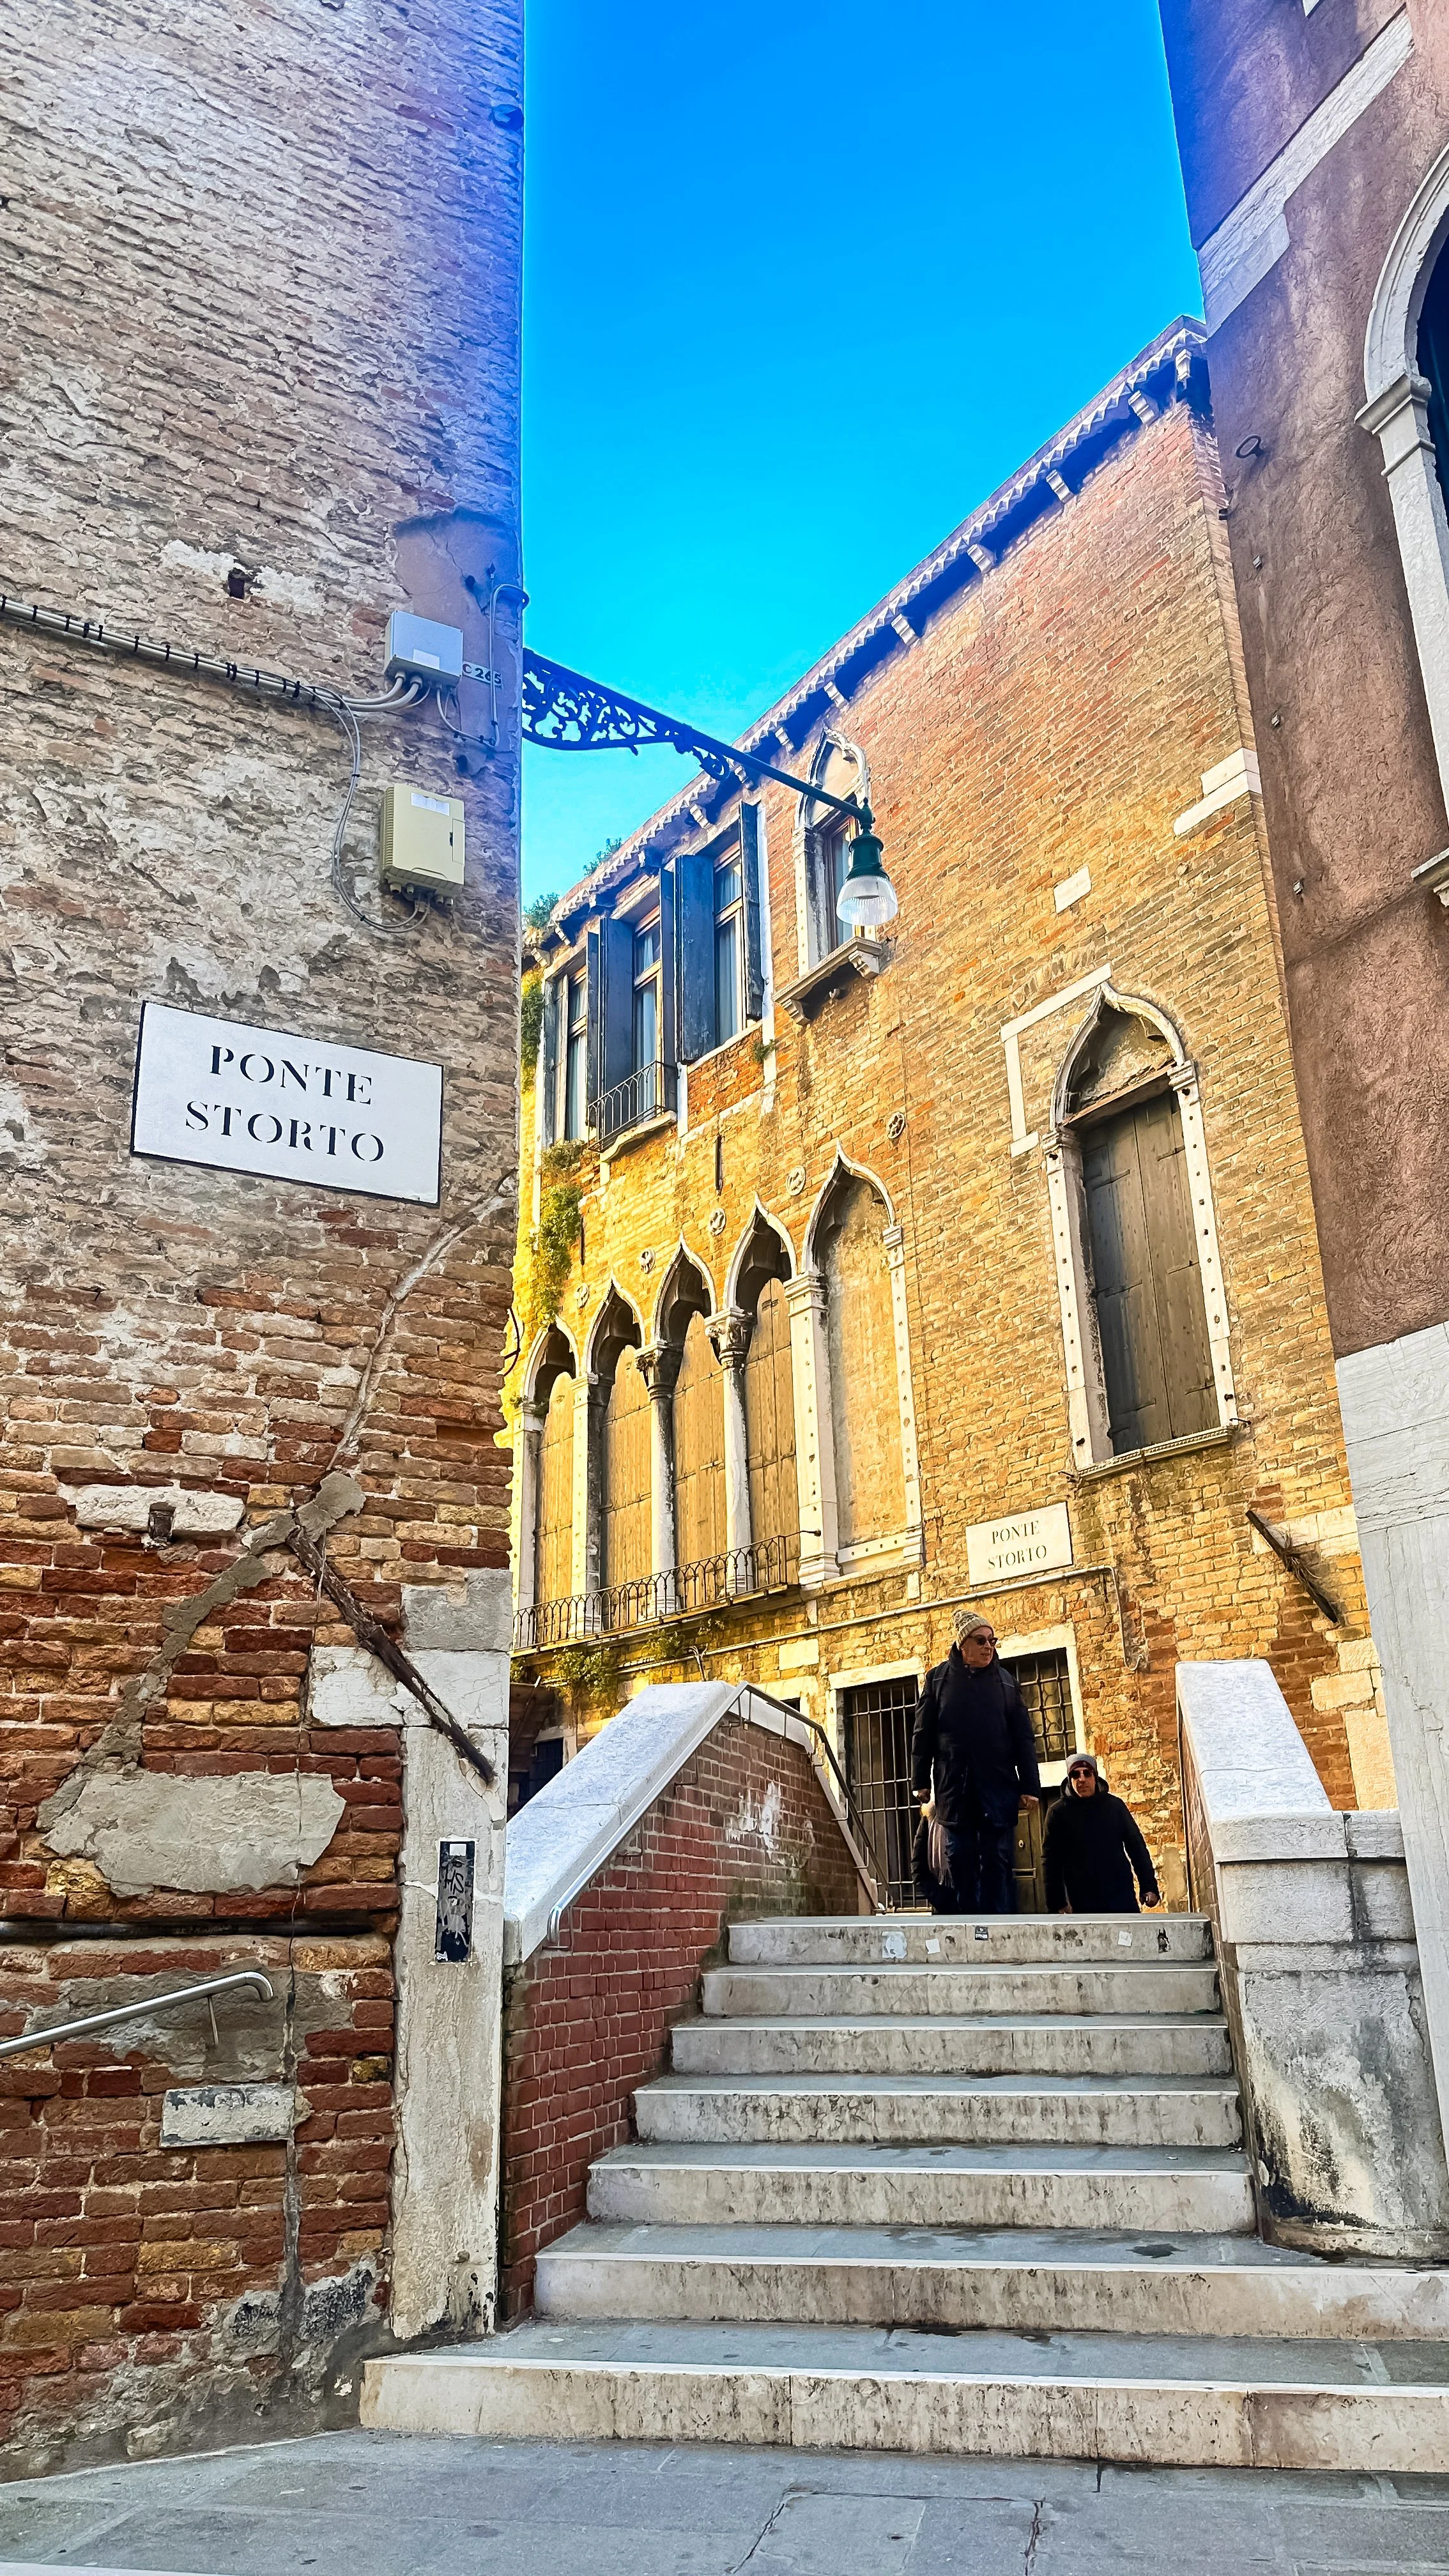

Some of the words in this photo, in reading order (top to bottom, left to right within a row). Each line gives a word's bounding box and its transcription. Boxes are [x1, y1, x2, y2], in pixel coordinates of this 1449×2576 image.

[210, 1045, 372, 1105] PONTE
[185, 1101, 385, 1162] STORTO
[992, 1521, 1039, 1545] PONTE
[988, 1545, 1047, 1570] STORTO
